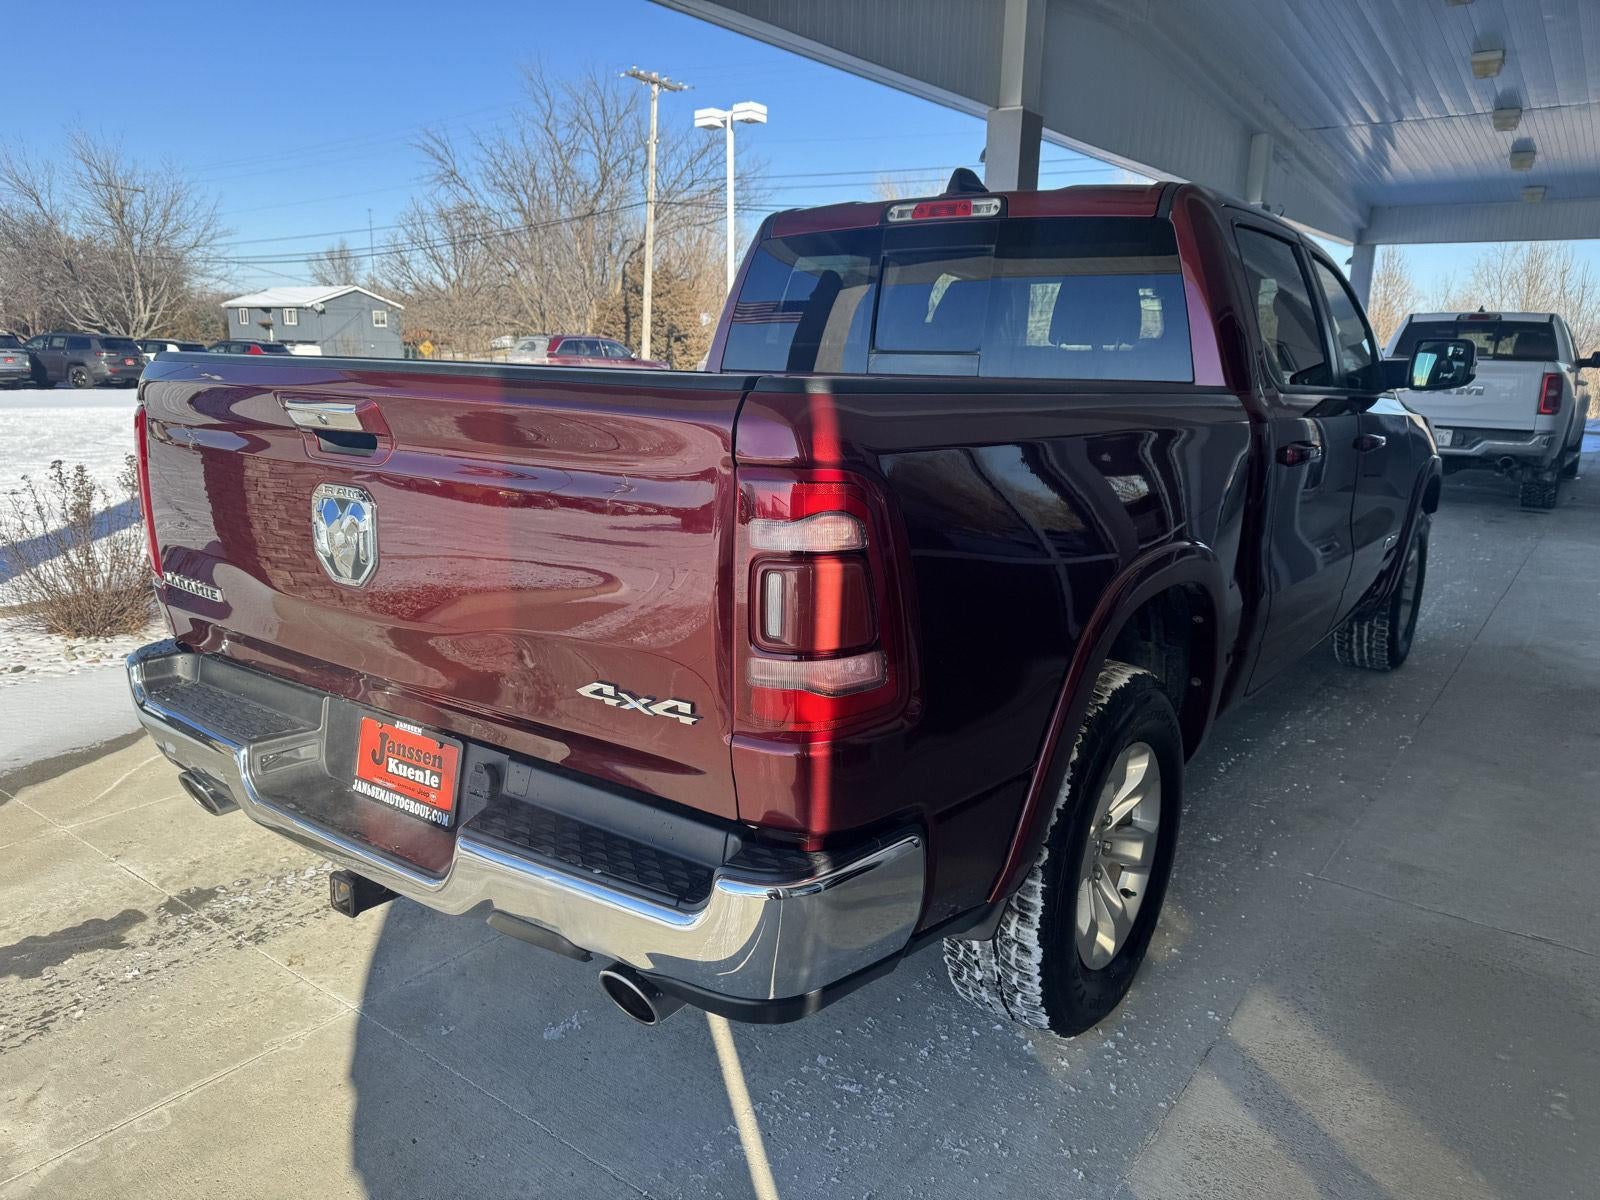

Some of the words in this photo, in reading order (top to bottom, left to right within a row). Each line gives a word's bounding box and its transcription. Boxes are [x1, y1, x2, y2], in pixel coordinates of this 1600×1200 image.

[323, 485, 361, 499] RAM
[164, 572, 220, 601] LARAMIE
[394, 720, 423, 735] JANSSEN
[371, 732, 442, 769] Janssen
[387, 757, 440, 788] Kuenle
[353, 779, 449, 827] JANSSENAUTOGROUP.COM
